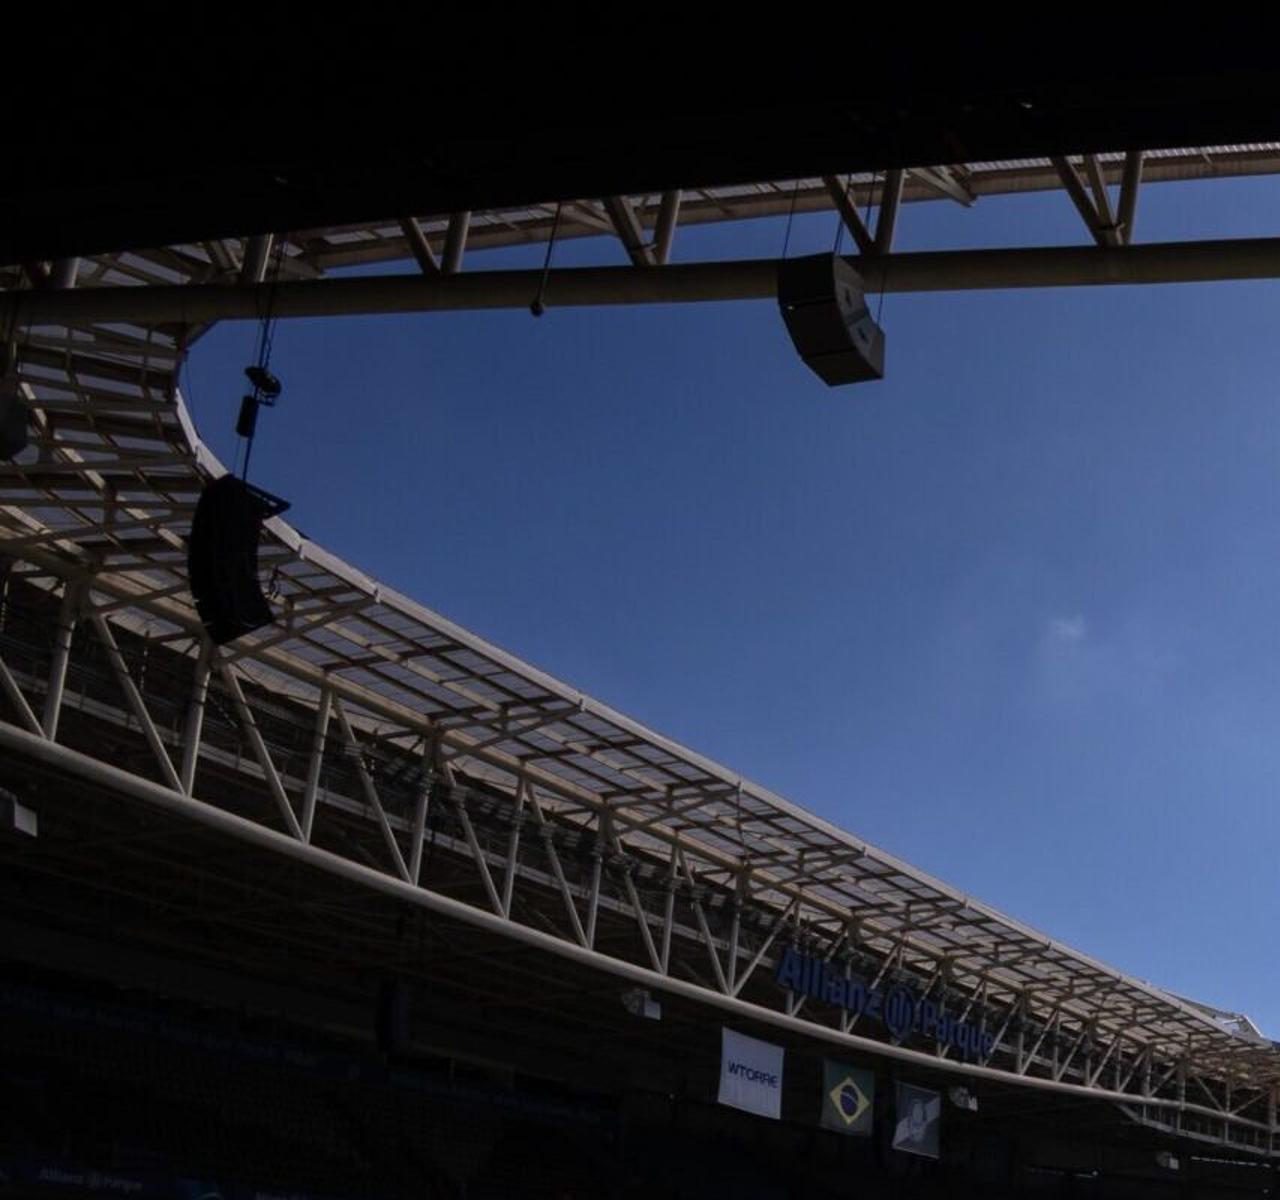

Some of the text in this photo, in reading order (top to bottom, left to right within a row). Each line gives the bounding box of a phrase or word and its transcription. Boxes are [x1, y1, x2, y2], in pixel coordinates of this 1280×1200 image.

[779, 945, 994, 1060] Allianz Parque
[728, 1060, 779, 1088] WTORRE
